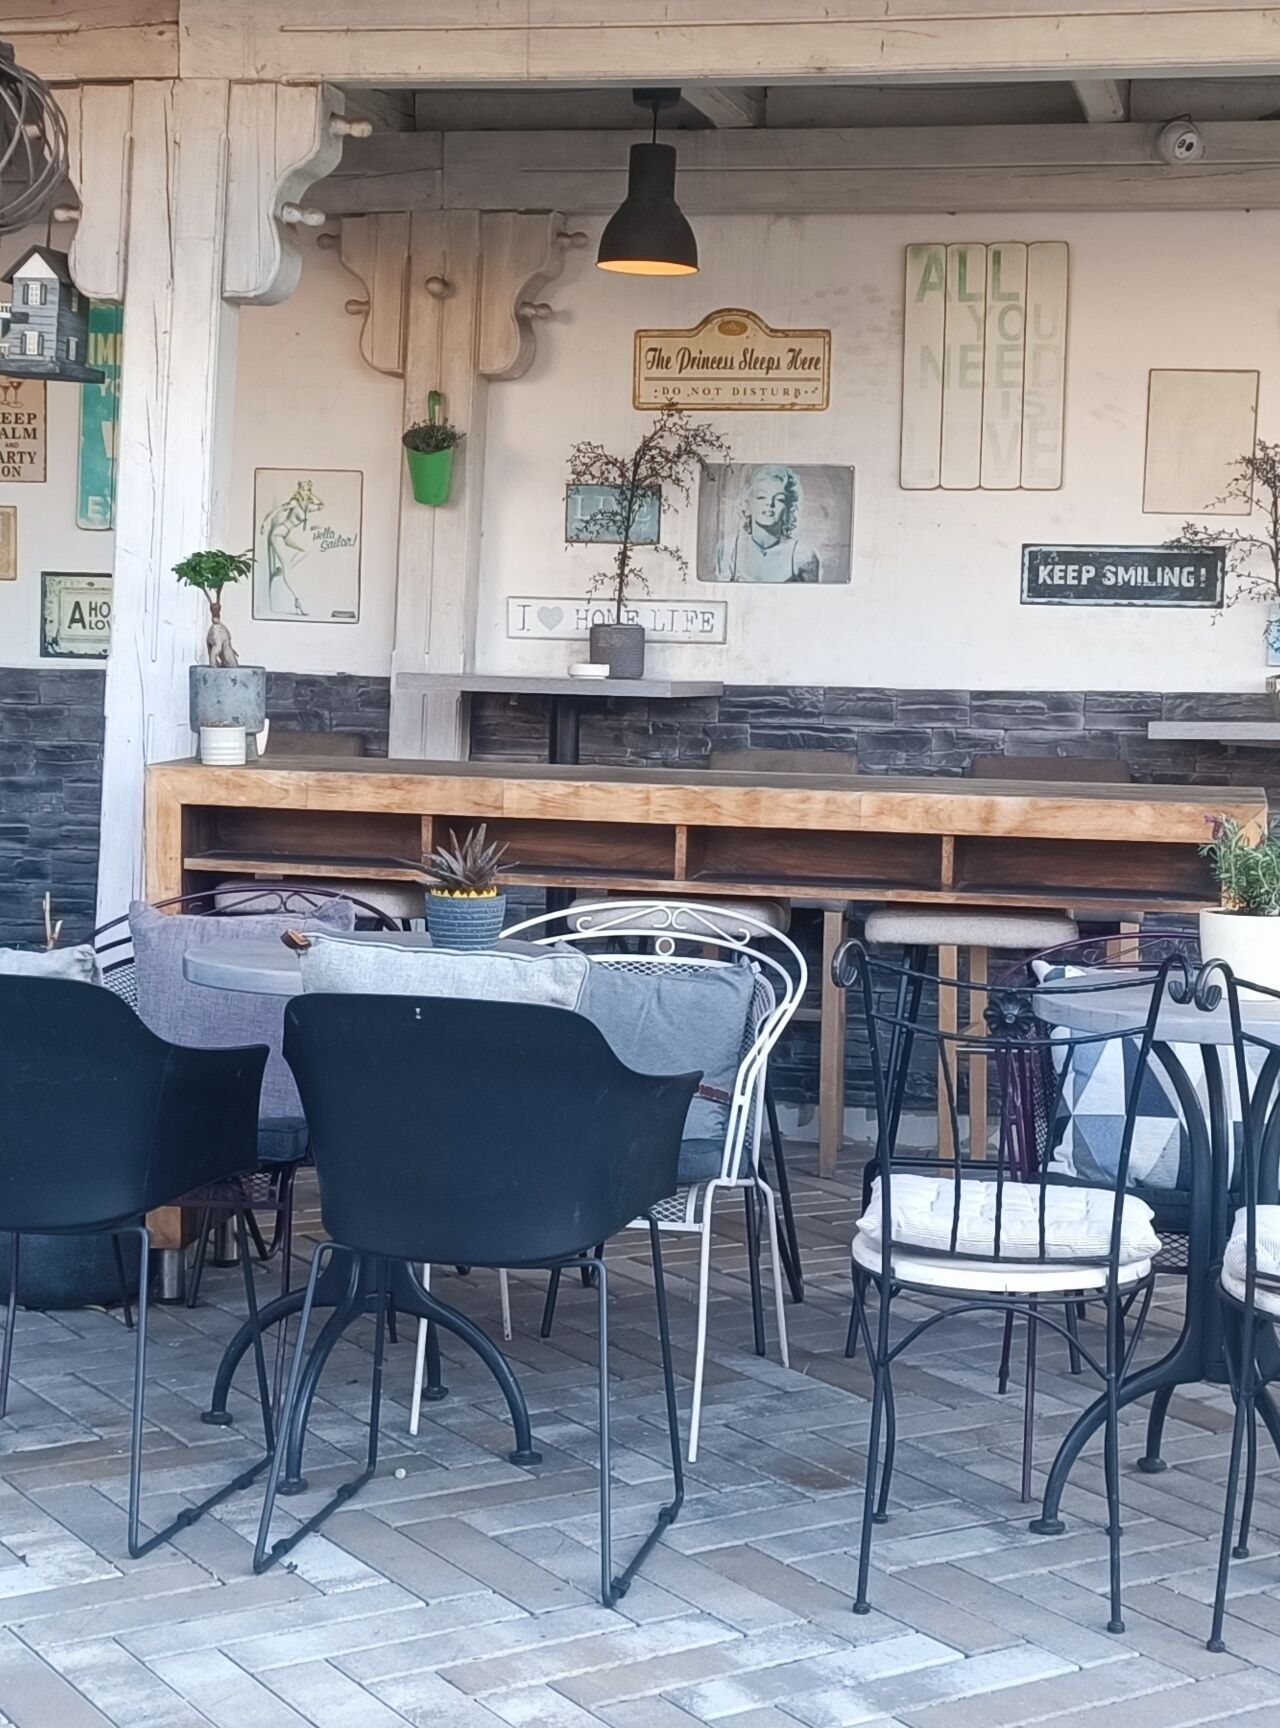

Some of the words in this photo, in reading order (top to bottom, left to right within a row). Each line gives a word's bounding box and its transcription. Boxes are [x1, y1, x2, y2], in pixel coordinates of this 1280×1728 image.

[914, 249, 1020, 303] ALL
[967, 304, 1060, 342] YOU
[645, 347, 672, 370] The
[675, 347, 734, 375] Princess
[739, 347, 782, 376] Sleeps
[786, 347, 821, 371] Here
[920, 343, 1061, 390] NEED
[662, 387, 681, 395] DO
[691, 387, 723, 396] NOT
[732, 387, 801, 398] DISTURB
[1000, 389, 1048, 420] IS
[1, 465, 22, 478] ON
[1037, 564, 1095, 586] KEEP
[1101, 565, 1207, 588] SMILING!
[67, 601, 87, 629] A
[516, 604, 532, 631] I
[649, 608, 715, 634] LIFE
